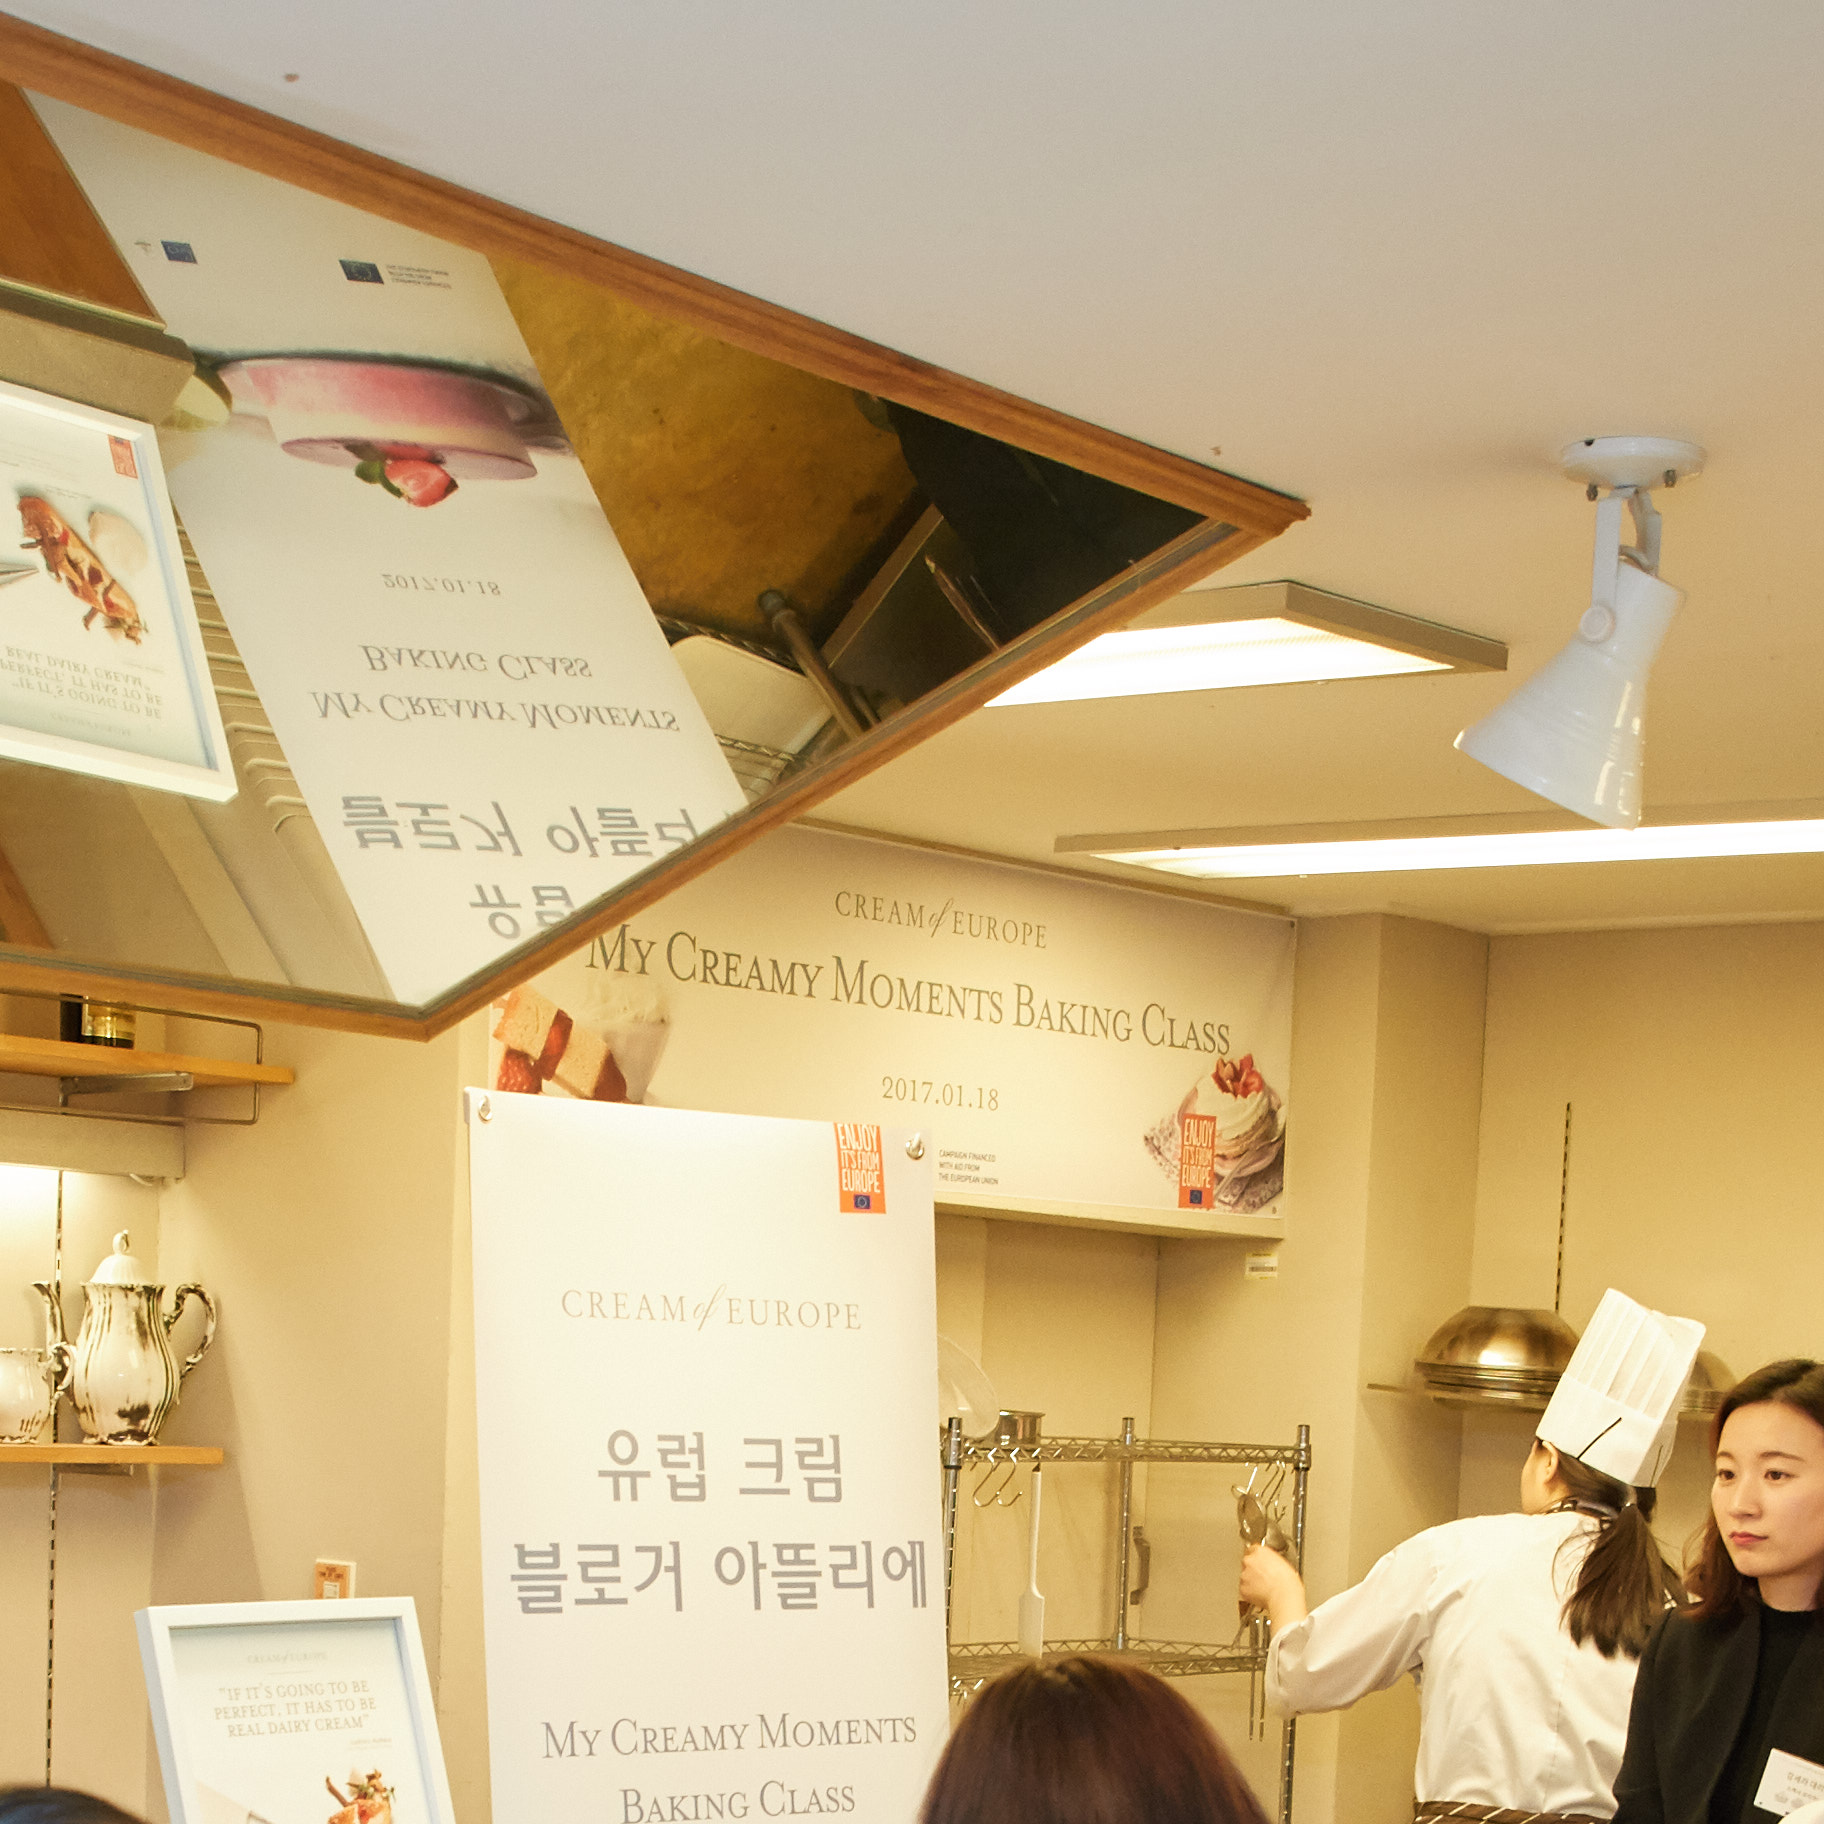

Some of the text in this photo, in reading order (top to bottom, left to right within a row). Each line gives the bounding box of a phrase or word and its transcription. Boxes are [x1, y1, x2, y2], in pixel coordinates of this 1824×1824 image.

[835, 890, 1047, 949] CREAM of EUROPE
[881, 1075, 999, 1112] 2017.01.18
[836, 1123, 878, 1151] ENJOY
[1184, 1118, 1214, 1148] ENJOY
[858, 1151, 880, 1171] FROM
[1181, 1164, 1211, 1188] EUROPE
[841, 1168, 881, 1193] EUROPE
[561, 1283, 862, 1332] CREAM of EUROPE
[597, 1429, 843, 1503] 유럽 크림
[510, 1541, 927, 1614] 블로거 아뜰리에
[276, 1682, 325, 1698] GOING
[328, 1680, 347, 1694] TO
[352, 1680, 369, 1693] BE
[286, 1702, 300, 1715] IT
[305, 1701, 333, 1714] HAS
[336, 1699, 355, 1712] TO
[360, 1697, 376, 1710] BE
[227, 1723, 264, 1737] REAL
[267, 1719, 310, 1734] DAIRY
[611, 1718, 749, 1755] CREAMY
[756, 1712, 918, 1749] MOMENTS
[619, 1780, 856, 1824] BAKING CLASS
